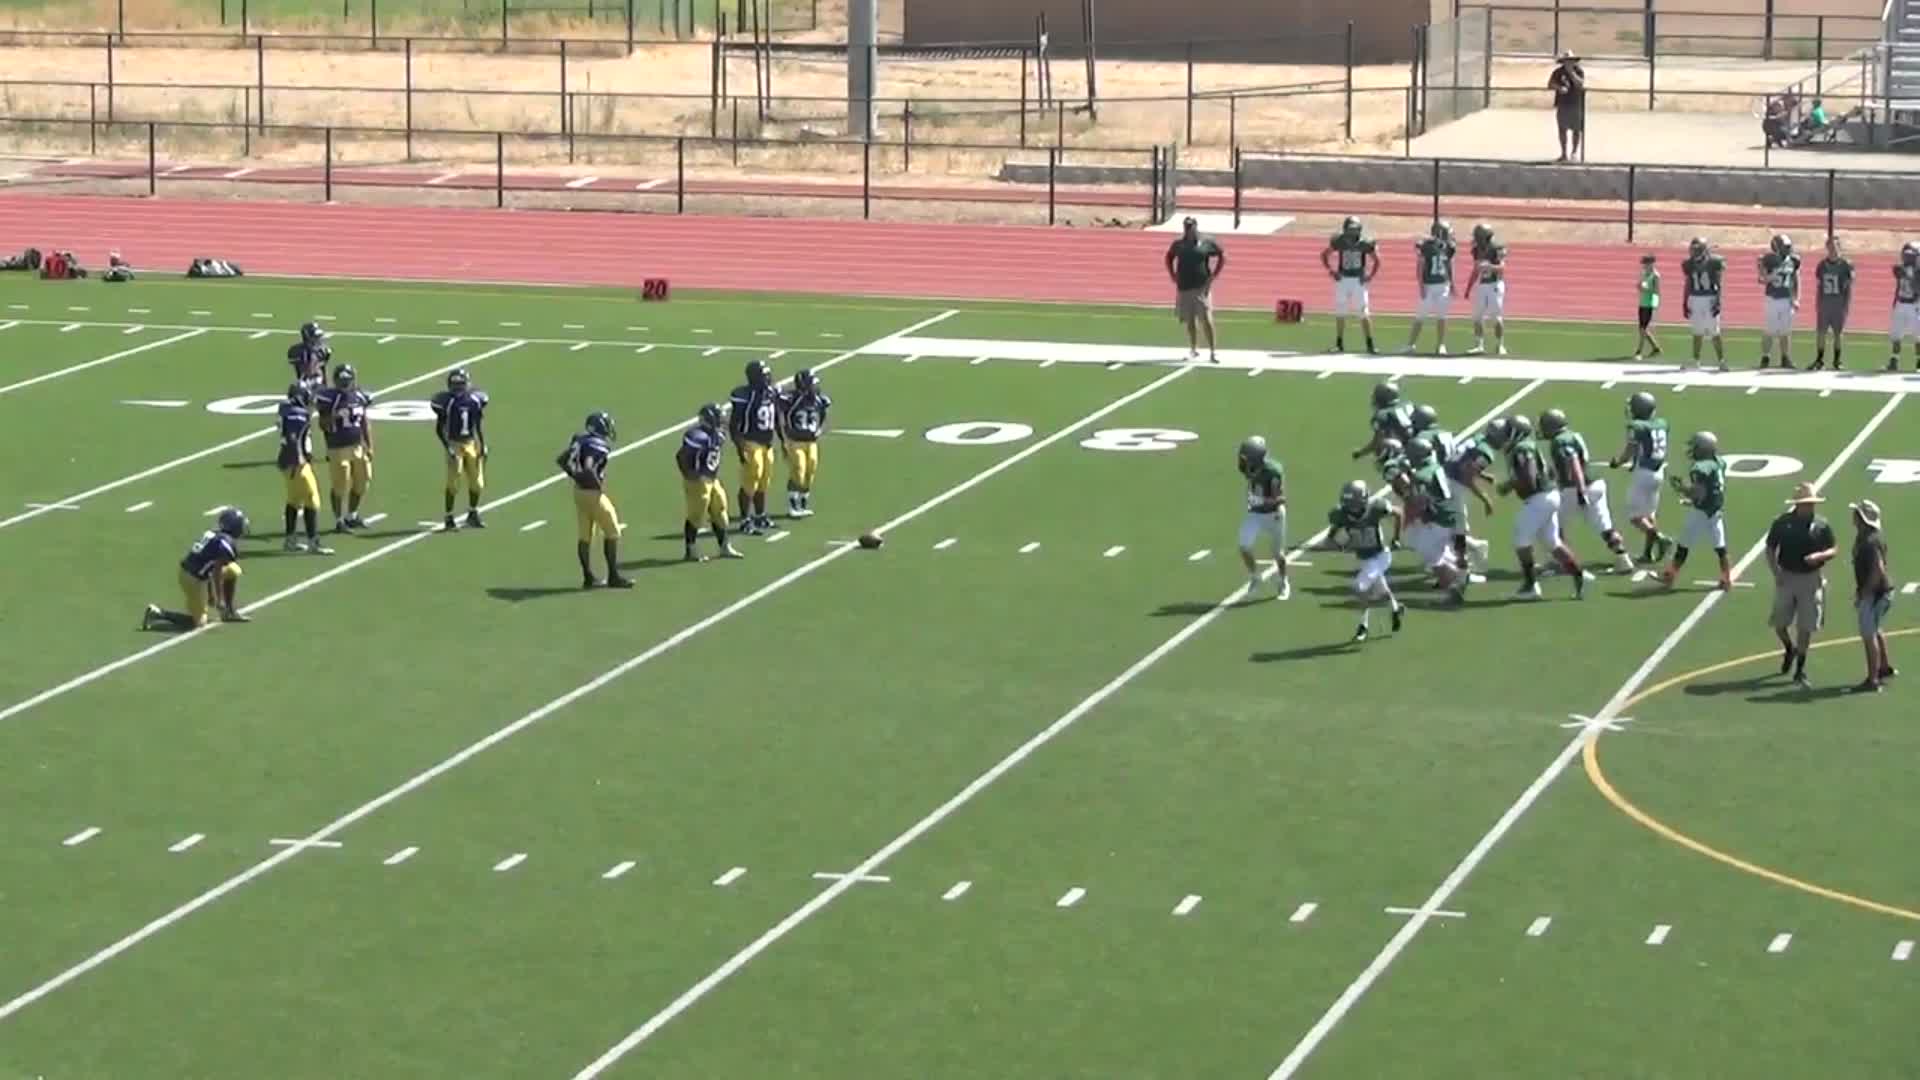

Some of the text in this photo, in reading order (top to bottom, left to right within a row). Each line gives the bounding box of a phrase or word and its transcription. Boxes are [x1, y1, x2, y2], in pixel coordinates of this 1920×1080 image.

[642, 279, 667, 300] 20
[1691, 272, 1711, 291] 14
[1822, 274, 1840, 294] 51
[1277, 299, 1303, 322] 30
[458, 407, 470, 435] 1
[756, 404, 775, 431] 91
